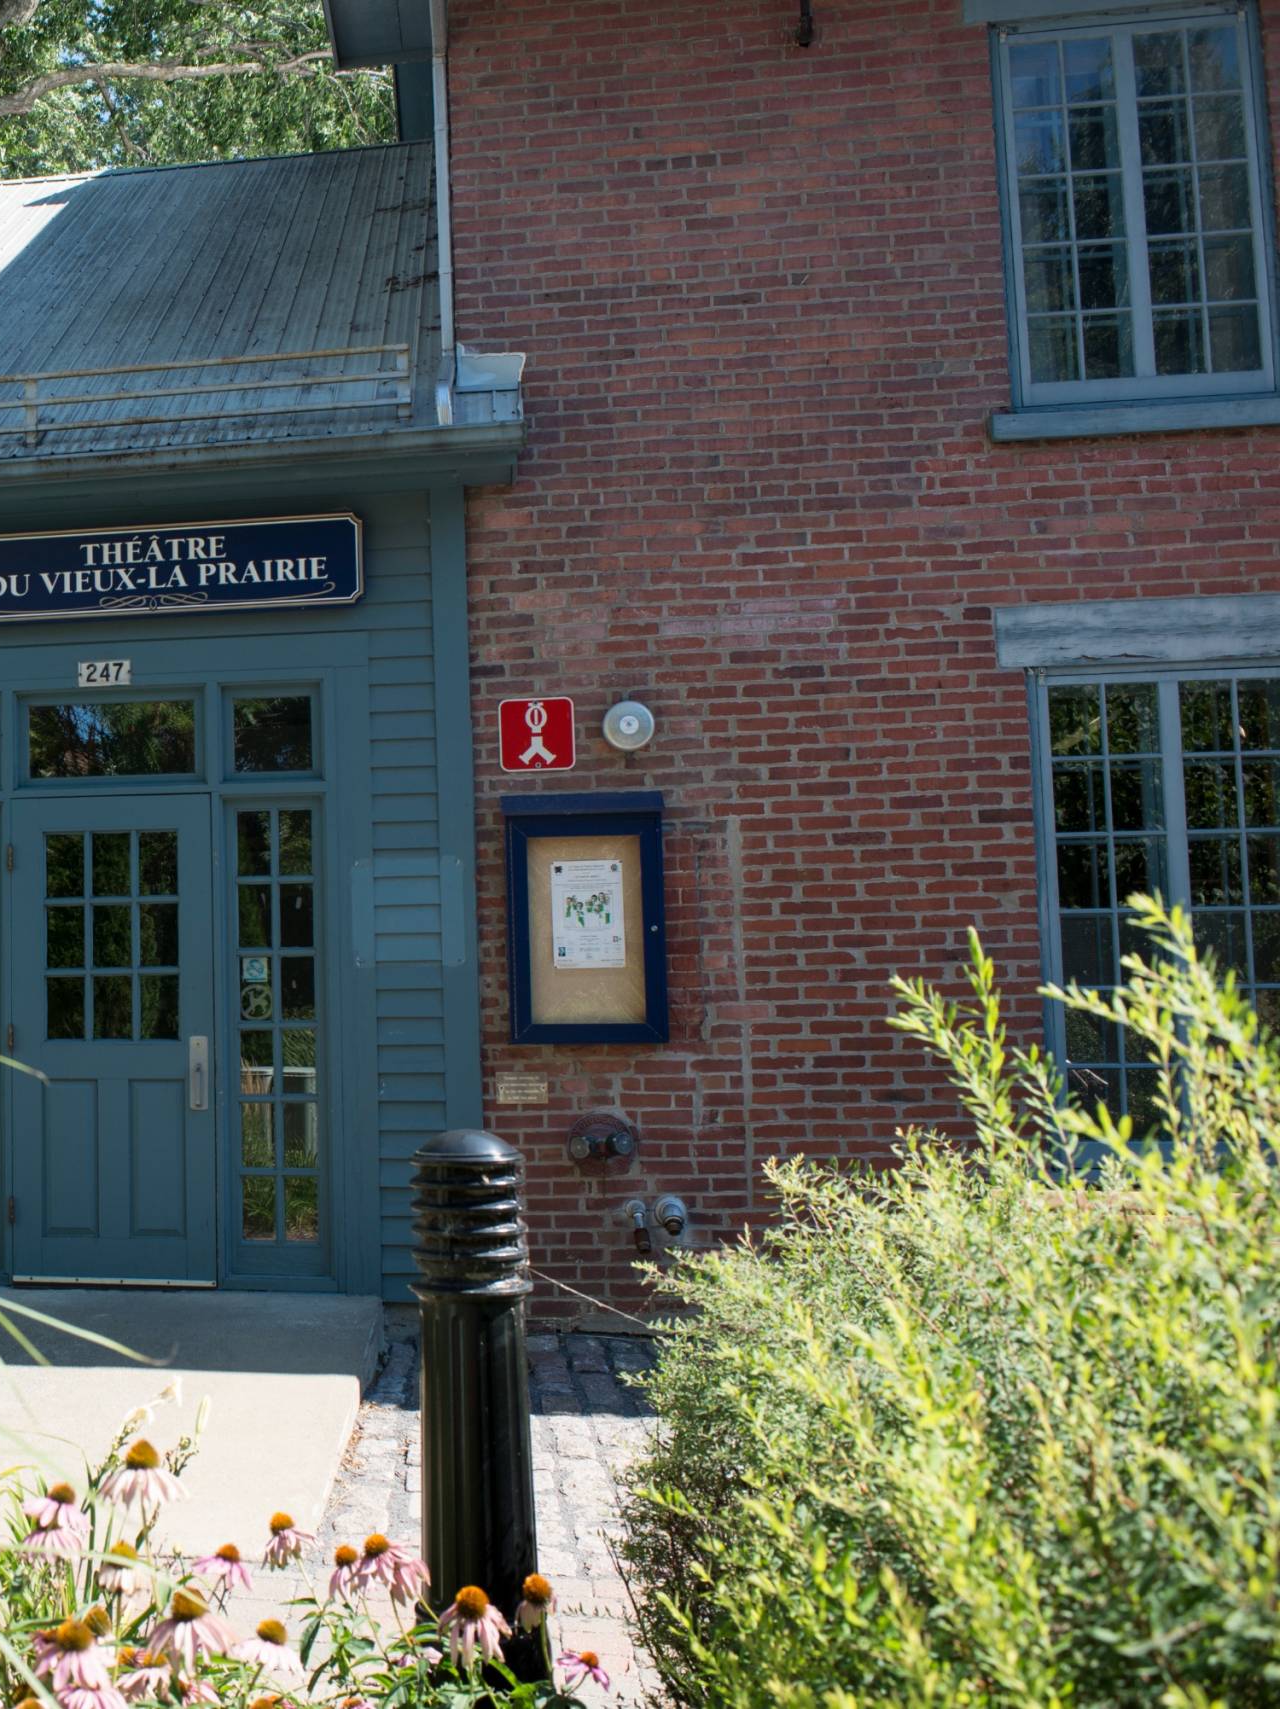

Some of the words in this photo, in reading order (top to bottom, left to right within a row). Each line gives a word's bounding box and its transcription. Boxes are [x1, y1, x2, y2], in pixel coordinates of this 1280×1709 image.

[80, 535, 227, 567] THÉÂTRE
[40, 567, 188, 594] VIEUX-LA
[197, 556, 329, 586] PRAIRIE
[86, 662, 124, 682] 247
